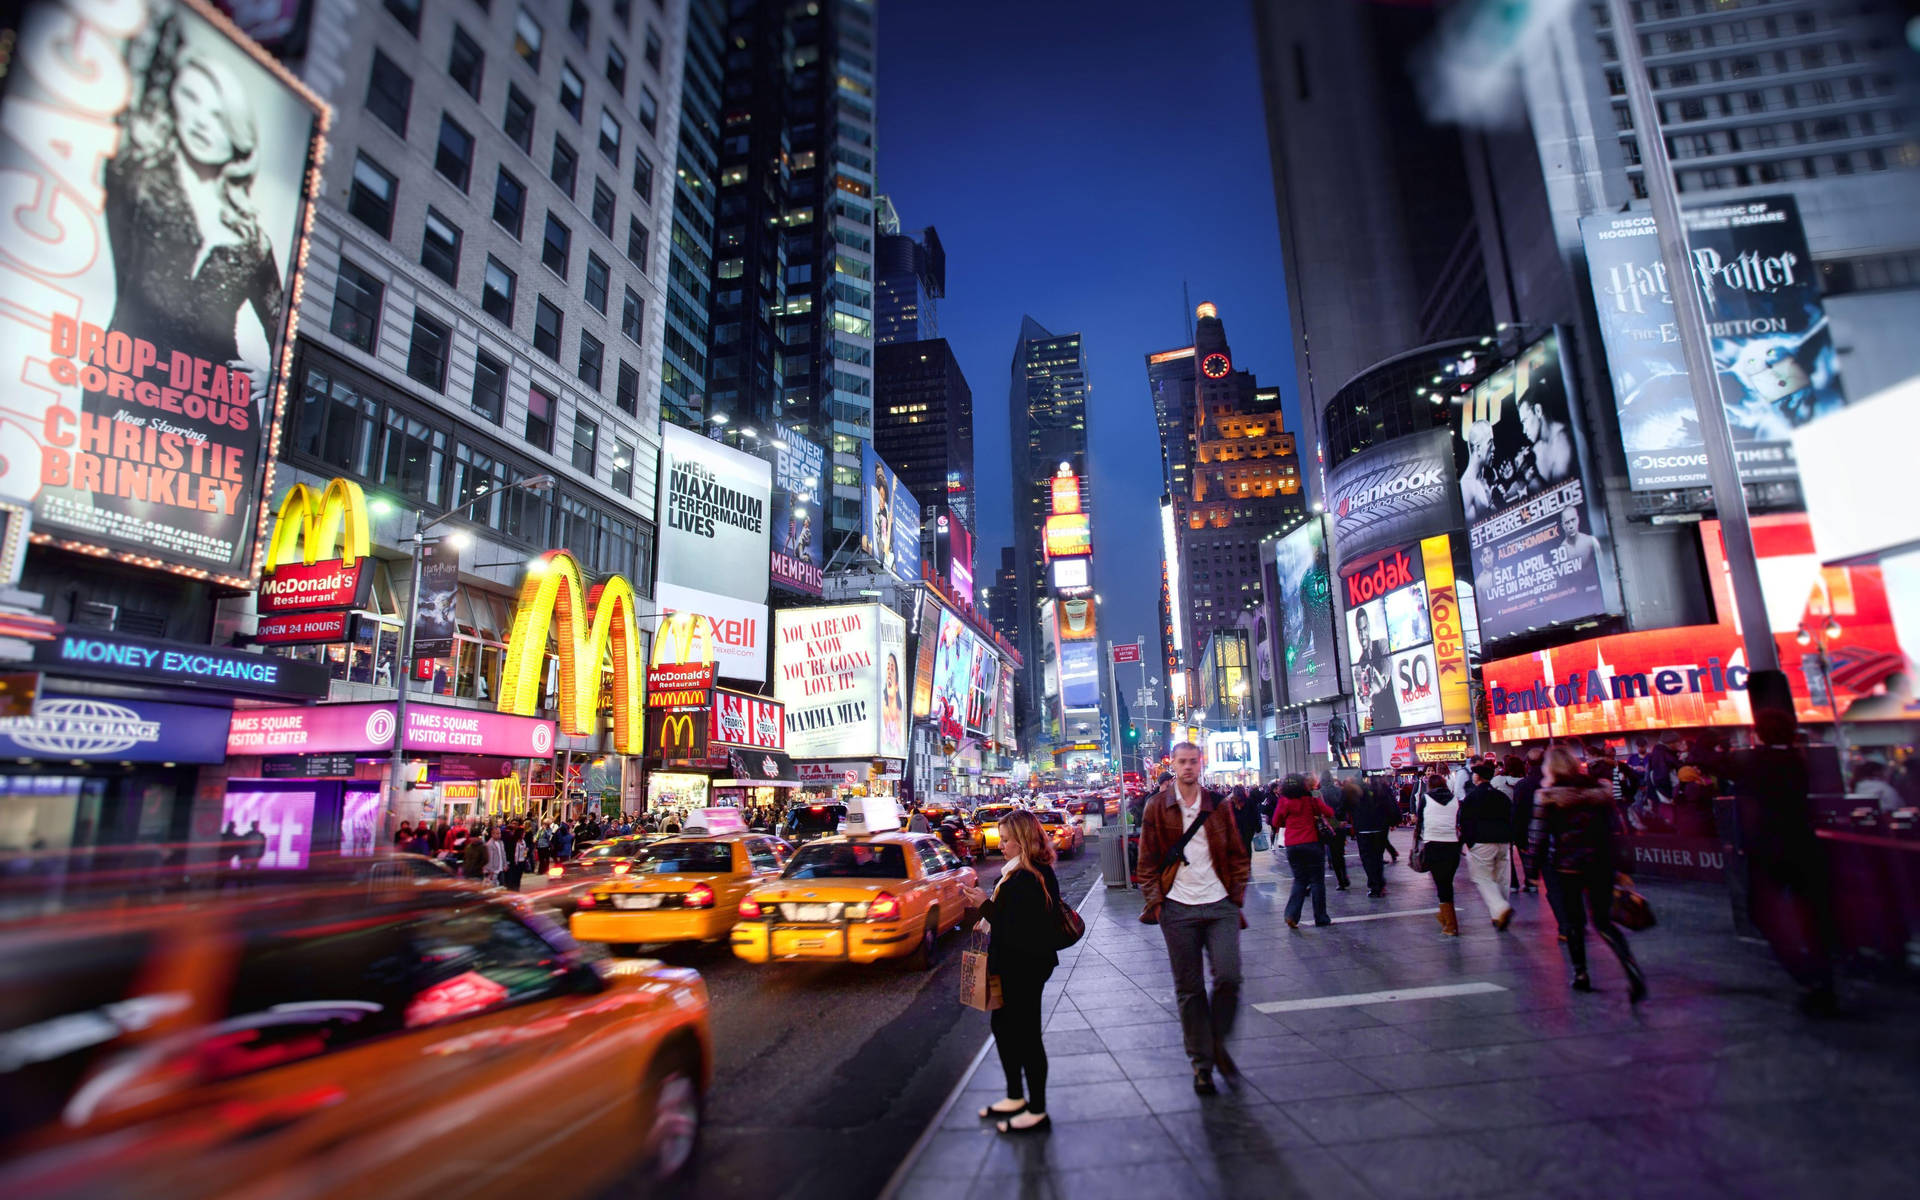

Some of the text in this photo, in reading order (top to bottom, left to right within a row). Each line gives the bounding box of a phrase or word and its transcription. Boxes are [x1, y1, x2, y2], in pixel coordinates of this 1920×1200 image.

[1732, 211, 1785, 226] SQUARE
[1749, 203, 1768, 213] OF
[1691, 247, 1797, 318] Potter
[50, 312, 251, 409] DROP-DEAD
[49, 356, 249, 431] GORGEOUS
[112, 409, 208, 445] Now Starring
[776, 422, 824, 462] WINNER!
[43, 404, 244, 483] CHRISTIE
[40, 445, 243, 516] BRINKLEY
[671, 453, 716, 482] WHERE
[777, 448, 821, 487] BEST
[1644, 475, 1678, 484] BLOCKS
[1678, 473, 1708, 482] SOUTH
[670, 469, 762, 520] MAXIMUM
[1360, 485, 1444, 514] driving emotion
[668, 507, 715, 539] LIVES
[669, 492, 762, 534] PERFORMANCE
[1470, 512, 1523, 547] ST-PIERRE
[1529, 482, 1583, 519] SHIELDS
[771, 551, 823, 589] MEMPHIS
[1517, 553, 1550, 578] APRIL
[1551, 546, 1567, 564] 30
[260, 573, 353, 595] McDonald's
[1347, 551, 1413, 607] Kodak
[1486, 586, 1506, 600] LIVE
[1506, 580, 1518, 594] ON
[1519, 557, 1583, 590] PAY-PER-VIEW
[273, 592, 337, 606] Restaurant
[258, 621, 341, 635] OPEN 24 HOURS
[783, 625, 807, 643] YOU
[810, 614, 862, 638] ALREADY
[1430, 585, 1462, 676] Kodak
[62, 638, 278, 683] MONEY EXCHANGE
[806, 637, 842, 658] KNOW
[650, 669, 710, 682] McDonald's
[783, 650, 871, 681] YOU'RE GONNA
[1397, 653, 1431, 693] SO
[804, 671, 855, 697] LOVE IT!
[1402, 682, 1432, 704] Kodak
[1490, 656, 1750, 716] Bank of Americ
[65, 722, 160, 737] EXCHANGE
[261, 715, 303, 731] SQUARE
[410, 713, 478, 731] TIMES SQUARE
[786, 707, 834, 733] MAMMA
[837, 700, 867, 725] MIA!
[267, 731, 308, 745] CENTER
[408, 729, 483, 746] VISITOR CENTER
[1414, 735, 1467, 743] MARQUIS
[1634, 847, 1694, 866] FATHER
